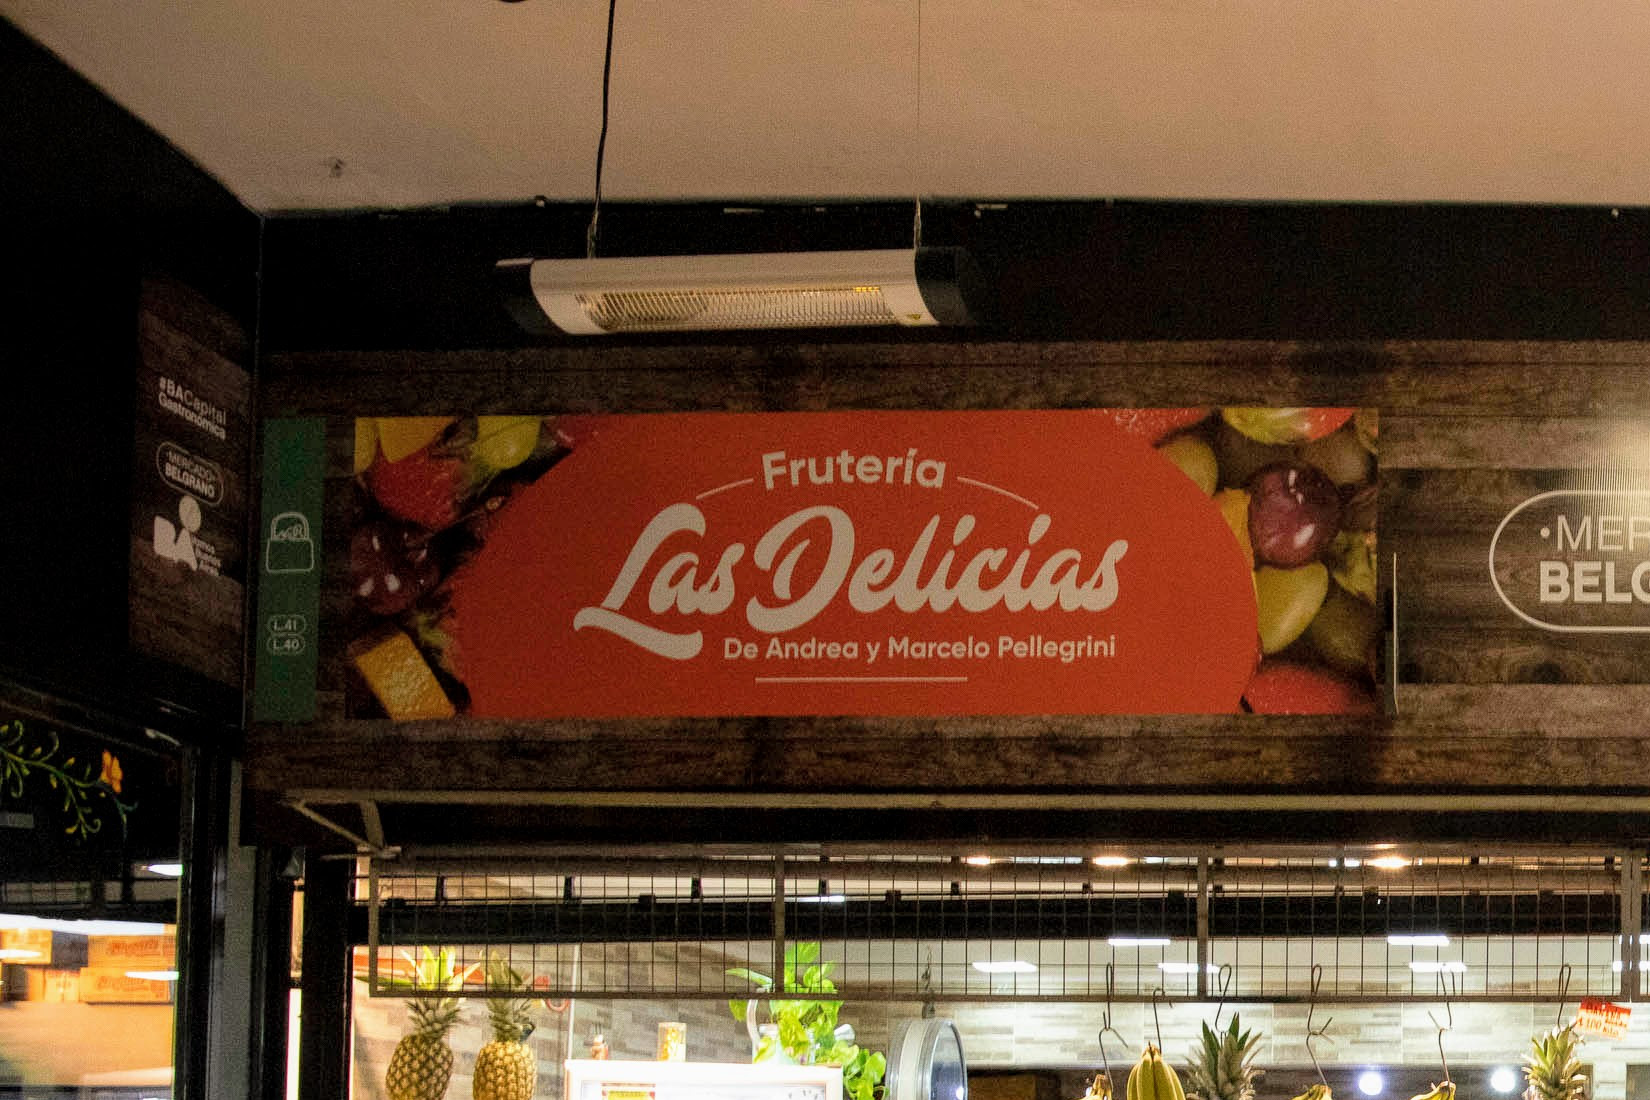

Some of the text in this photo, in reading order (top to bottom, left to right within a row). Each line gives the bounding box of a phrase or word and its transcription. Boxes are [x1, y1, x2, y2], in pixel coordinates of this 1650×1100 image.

[159, 376, 226, 425] #BACapital
[165, 462, 215, 498] BELGRANO
[760, 447, 947, 491] Frutería
[573, 502, 1129, 660] Las Delicias
[723, 634, 1116, 664] De Andrea y Marcelo Pellegrini
